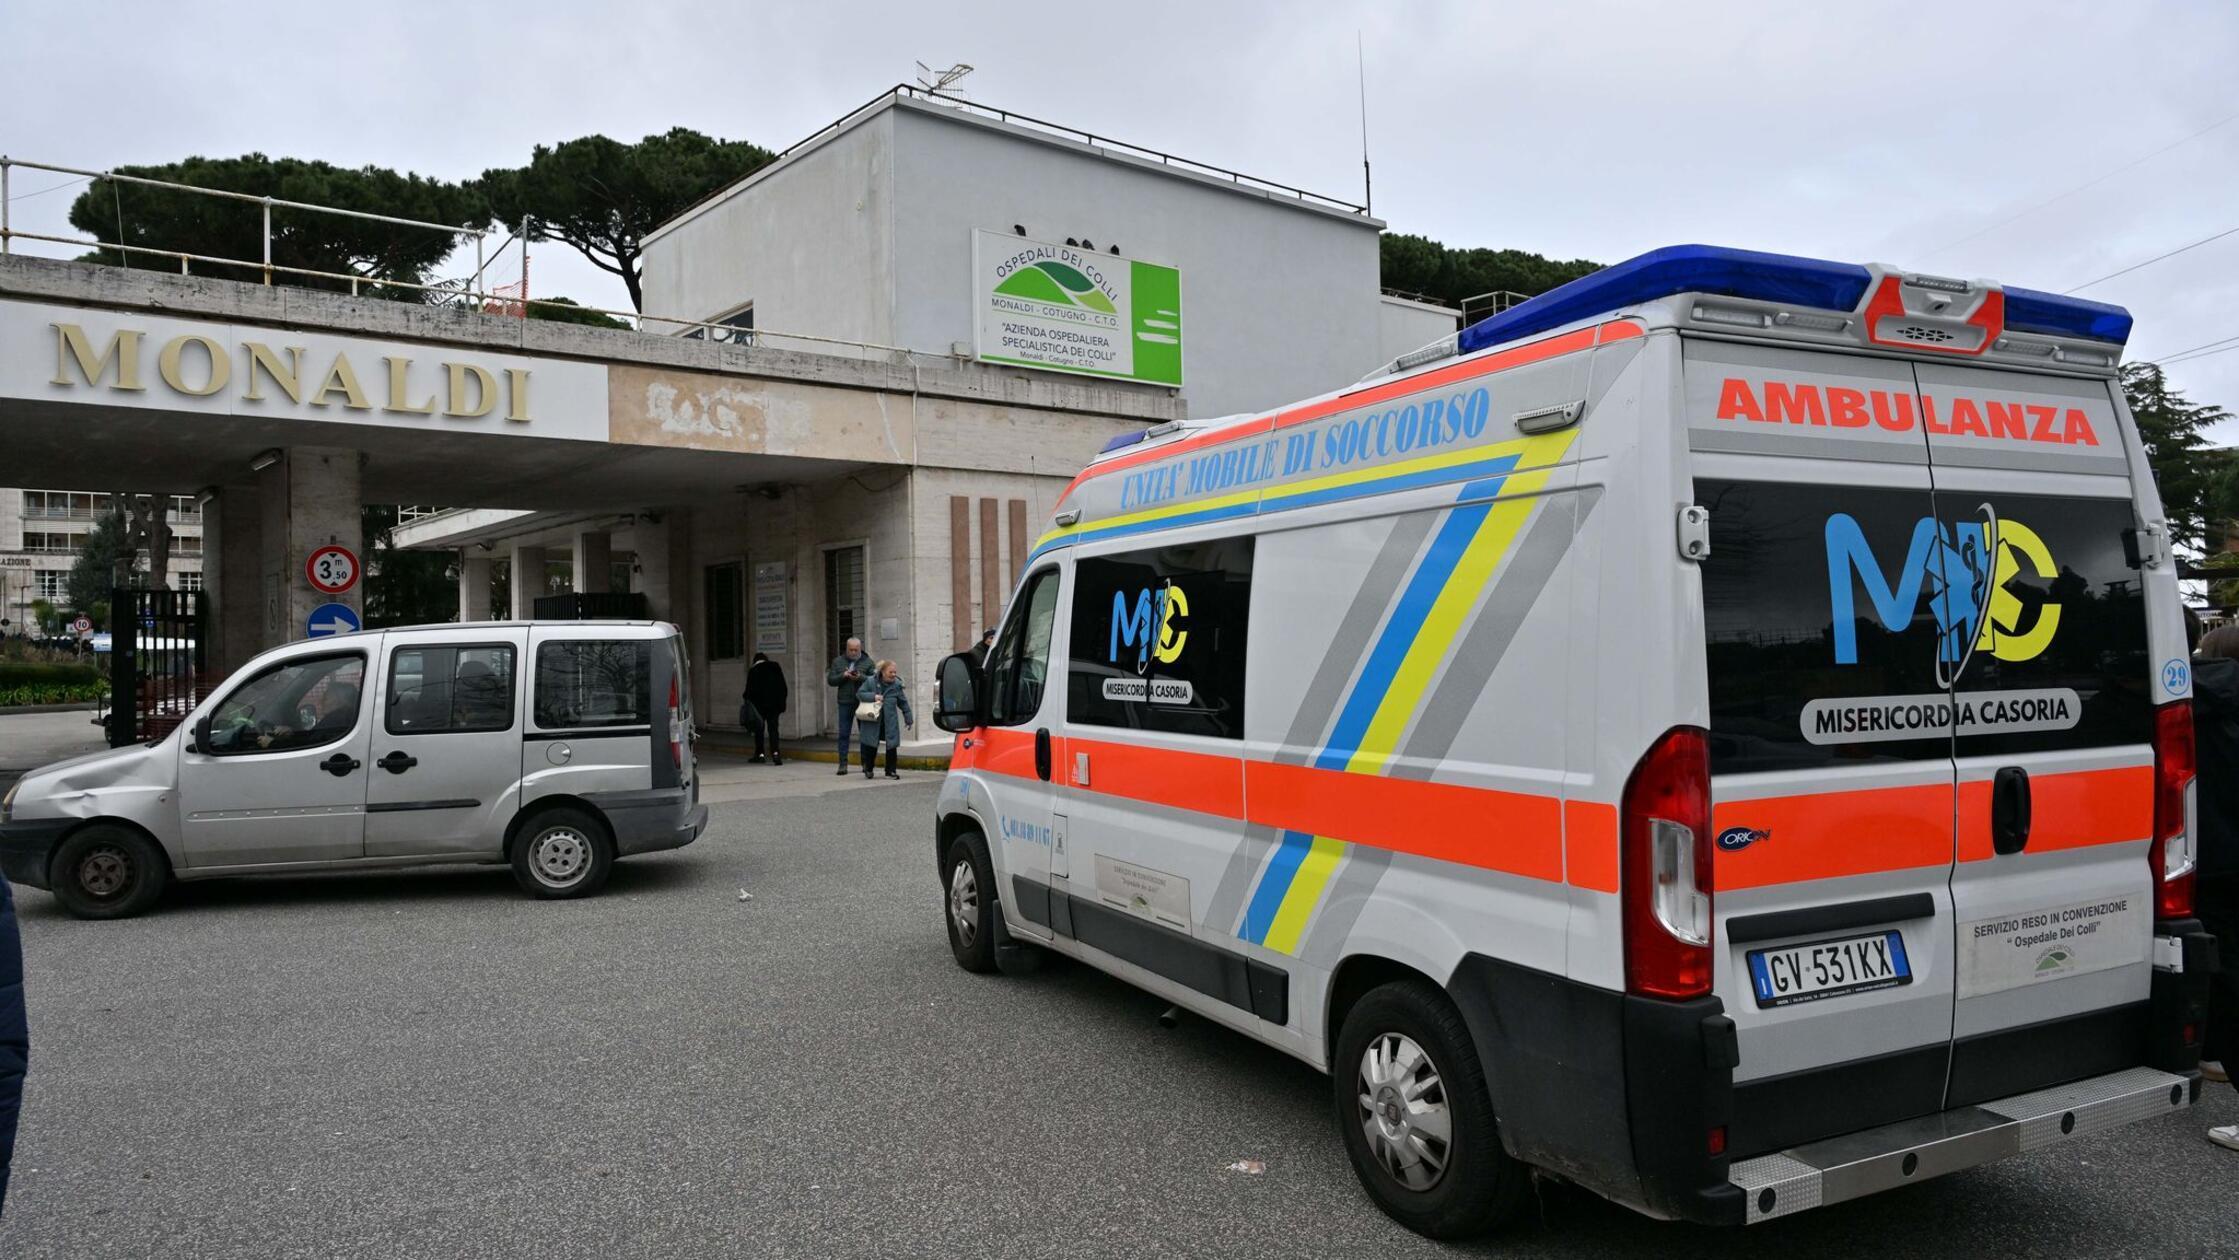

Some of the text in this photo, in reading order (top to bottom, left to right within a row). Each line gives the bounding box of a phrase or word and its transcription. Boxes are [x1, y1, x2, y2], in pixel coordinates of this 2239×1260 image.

[996, 247, 1118, 302] OSPEDALI DEI COLLI
[991, 298, 1034, 313] MONALDI
[1042, 306, 1086, 321] COTUGNO
[1094, 315, 1119, 327] C.T.O.
[1002, 336, 1068, 355] SPECIALISTICA
[1070, 346, 1085, 357] DEI
[1048, 329, 1110, 347] OSPEDALIERA
[1019, 351, 1043, 360] Monaldi
[1048, 355, 1073, 365] Cotugno
[48, 322, 532, 422] MONALDI
[1716, 378, 2100, 447] AMBULANZA
[1185, 441, 1278, 496] MOBILE
[1282, 430, 1316, 477] DI
[1320, 387, 1490, 469] SOCCORSO
[78, 620, 87, 629] 10
[2167, 666, 2186, 687] 29
[1155, 685, 1188, 699] CASORIA
[1815, 698, 2069, 734] MISERICORDIA CASORIA
[1974, 900, 2127, 938] SERVIZIO RESO IN CONVENZIONE
[2014, 931, 2058, 948] Ospedale
[2060, 926, 2075, 938] Dei
